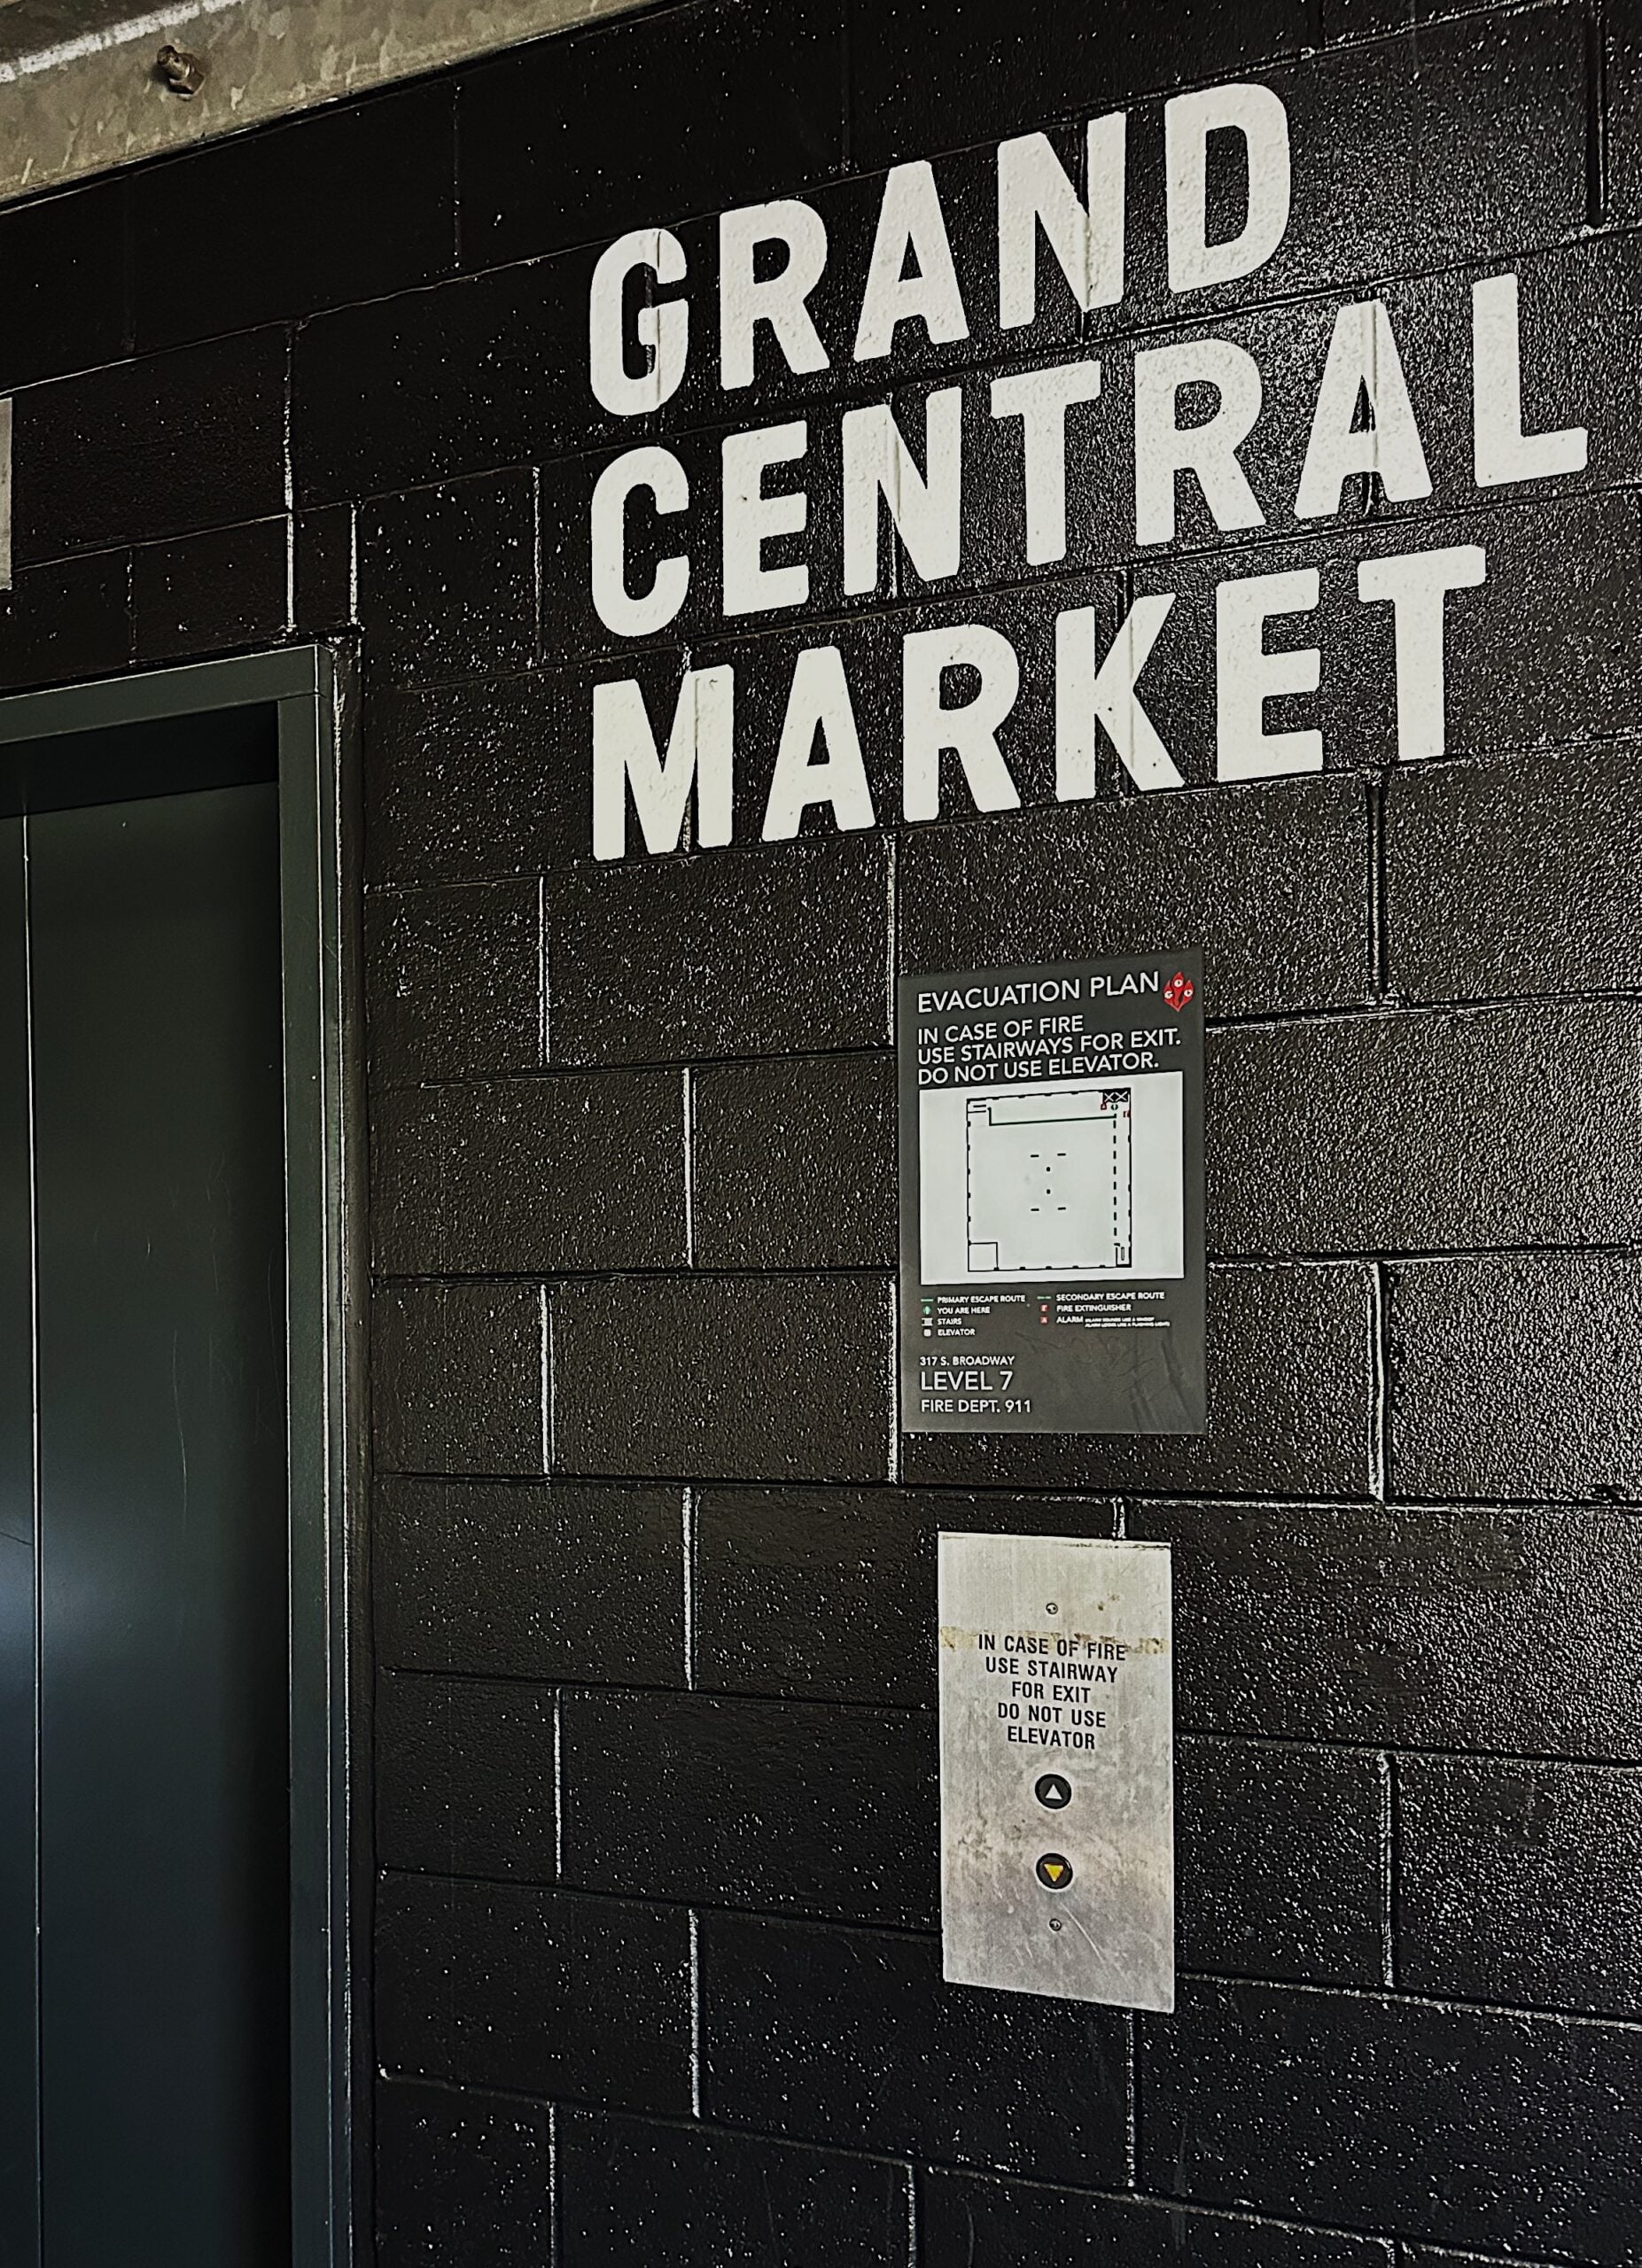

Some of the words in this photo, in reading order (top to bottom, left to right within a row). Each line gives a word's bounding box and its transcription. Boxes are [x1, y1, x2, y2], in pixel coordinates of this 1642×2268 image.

[589, 82, 1292, 417] GRAND
[590, 271, 1589, 639] CENTRAL
[592, 544, 1487, 861] MARKET
[917, 979, 1080, 1014] EVACUATION
[1090, 971, 1159, 998] PLAN
[917, 1027, 938, 1045] IN
[945, 1022, 997, 1044] CASE
[1003, 1019, 1033, 1037] OF
[1039, 1015, 1084, 1034] FIRE
[918, 1045, 954, 1065] USE
[961, 1037, 1073, 1061] STAIRWAYS
[1080, 1033, 1124, 1052] FOR
[1131, 1028, 1180, 1048] EXIT.
[919, 1067, 949, 1085] DO
[954, 1063, 999, 1084] NOT
[1004, 1060, 1042, 1080] USE
[1048, 1052, 1159, 1076] ELEVATOR.
[1074, 1303, 1132, 1312] EXTINGUISHER
[1137, 1292, 1165, 1301] ROUTE
[920, 1356, 938, 1366] 317
[940, 1356, 950, 1366] S.
[953, 1355, 1015, 1366] BROADWAY
[921, 1371, 993, 1391] LEVEL
[1000, 1371, 1014, 1391] 7
[921, 1400, 953, 1413] FIRE
[958, 1400, 1000, 1413] DEPT.
[1005, 1400, 1031, 1413] 911
[978, 1634, 996, 1651] IN
[1004, 1635, 1048, 1654] CASE
[1056, 1639, 1078, 1657] OF
[1086, 1642, 1126, 1661] FIRE
[985, 1656, 1019, 1675] USE
[1027, 1658, 1118, 1682] STAIRWAY
[1011, 1682, 1045, 1701] FOR
[1053, 1684, 1092, 1704] EXIT
[998, 1702, 1021, 1720] DO
[1028, 1705, 1062, 1724] NOT
[1070, 1708, 1106, 1728] USE
[1008, 1725, 1095, 1750] ELEVATOR
